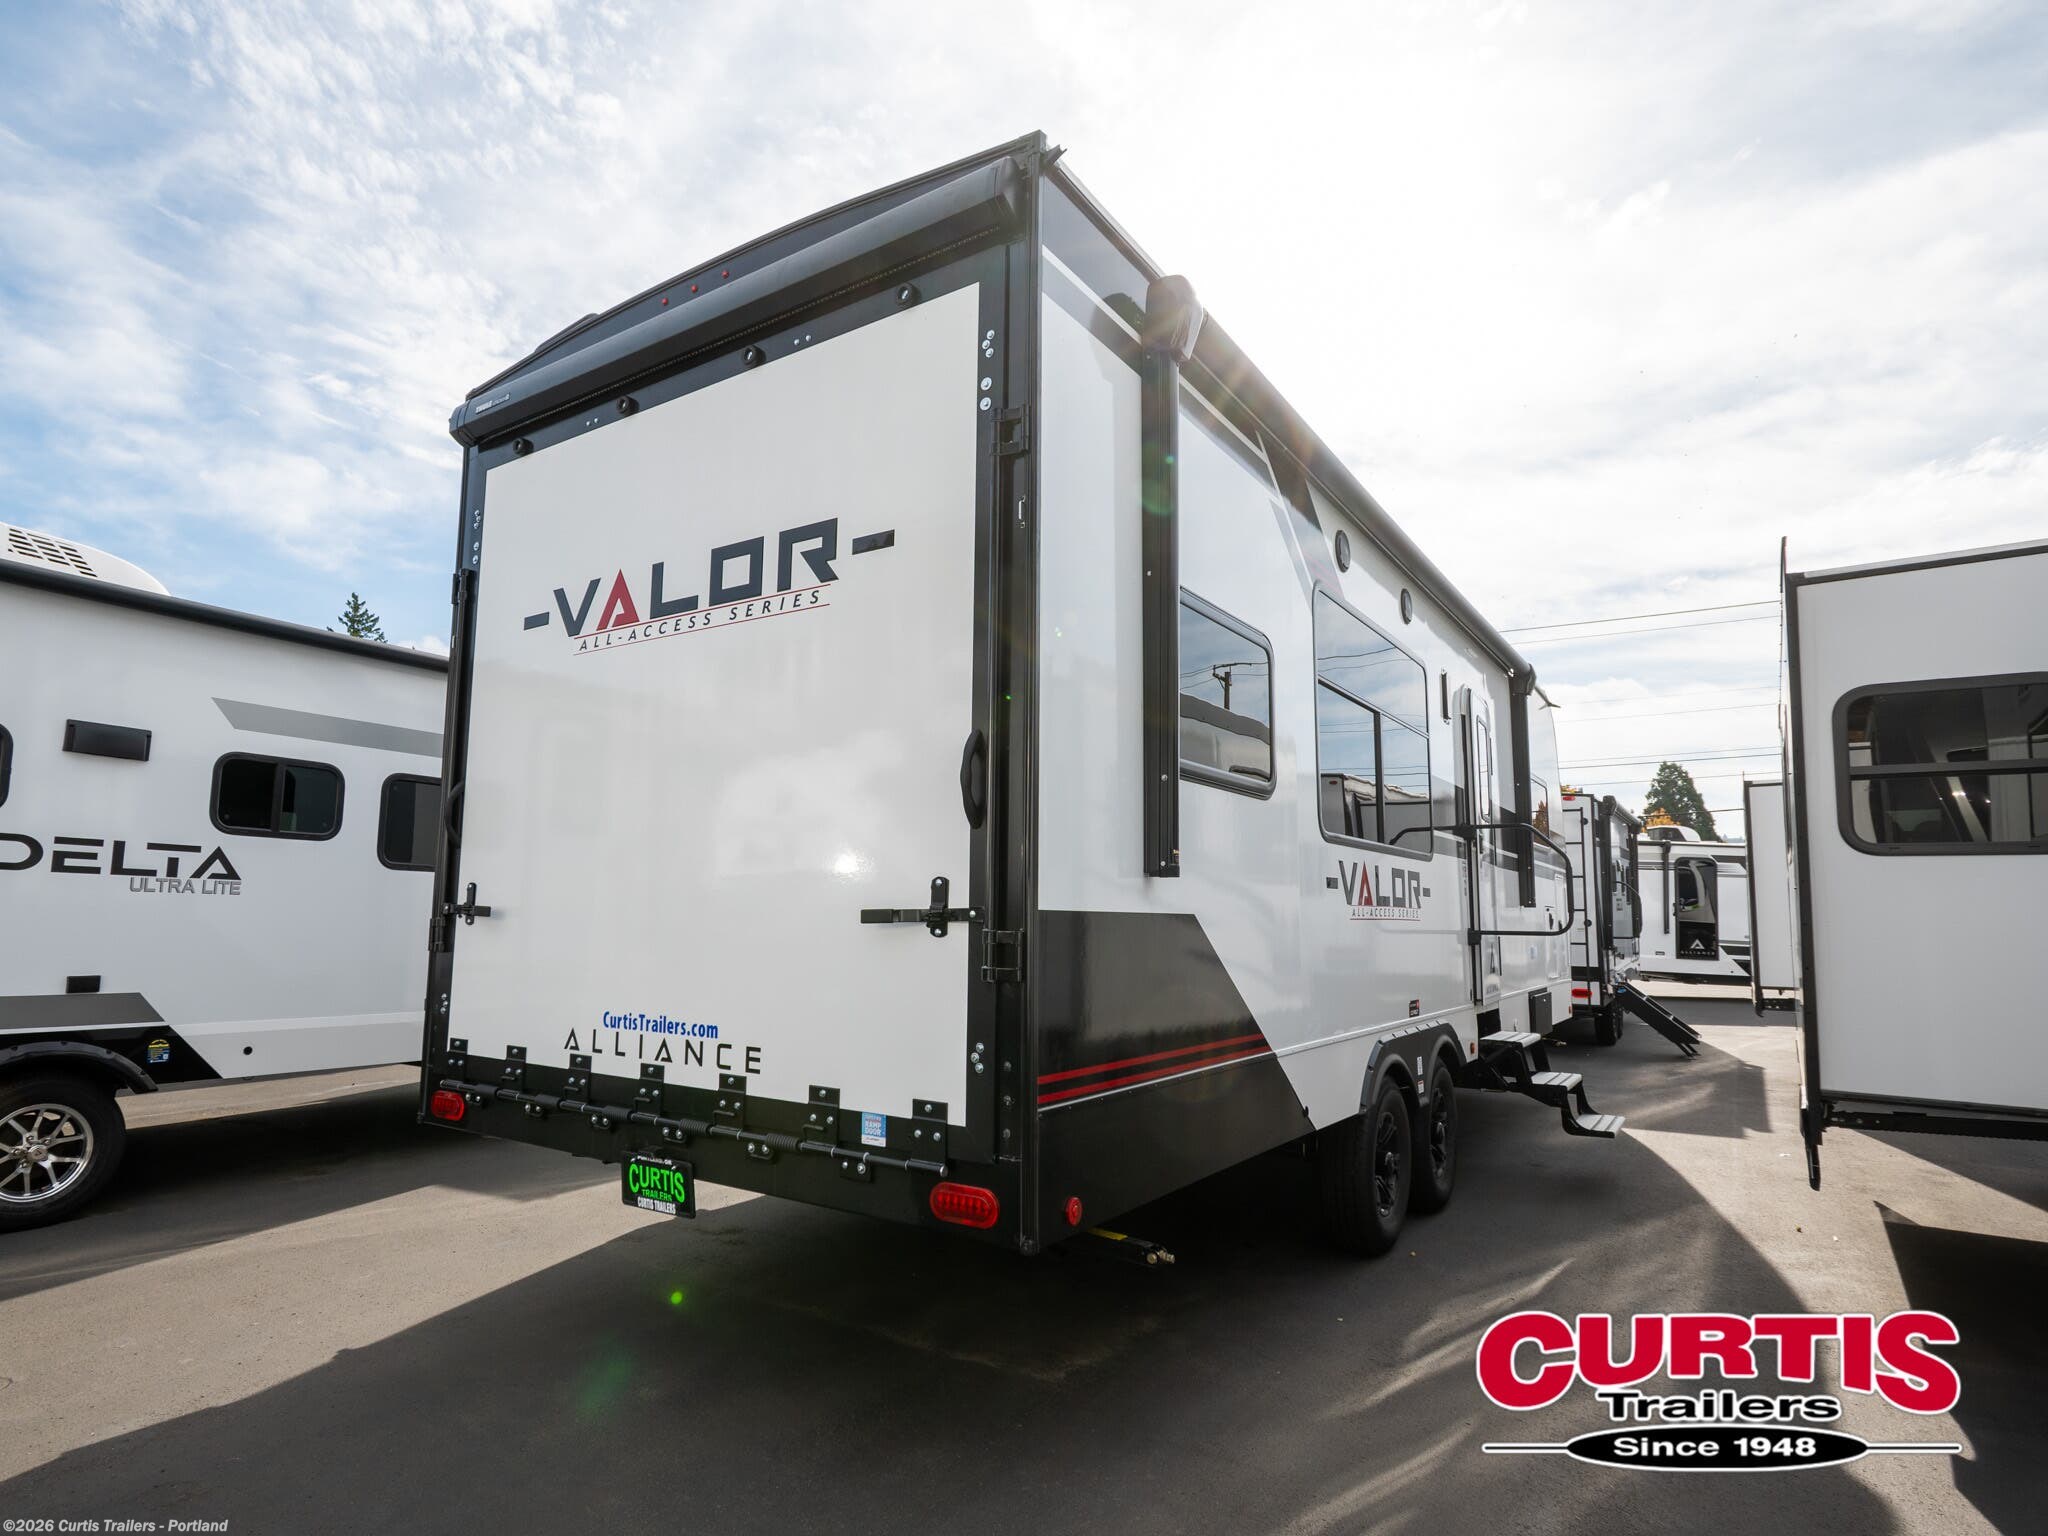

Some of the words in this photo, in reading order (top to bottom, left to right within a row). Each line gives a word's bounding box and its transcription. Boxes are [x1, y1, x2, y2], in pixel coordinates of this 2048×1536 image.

[578, 612, 712, 652] ALL-ACCESS
[727, 589, 821, 621] SERIES
[0, 832, 242, 881] DELTA
[128, 876, 196, 895] ULTRA
[201, 878, 242, 896] LITE
[602, 1010, 719, 1040] CurtisTrailers.com
[563, 1026, 762, 1075] ALLIANCE
[629, 1164, 685, 1203] CURTIS
[641, 1189, 673, 1201] TRAILERS
